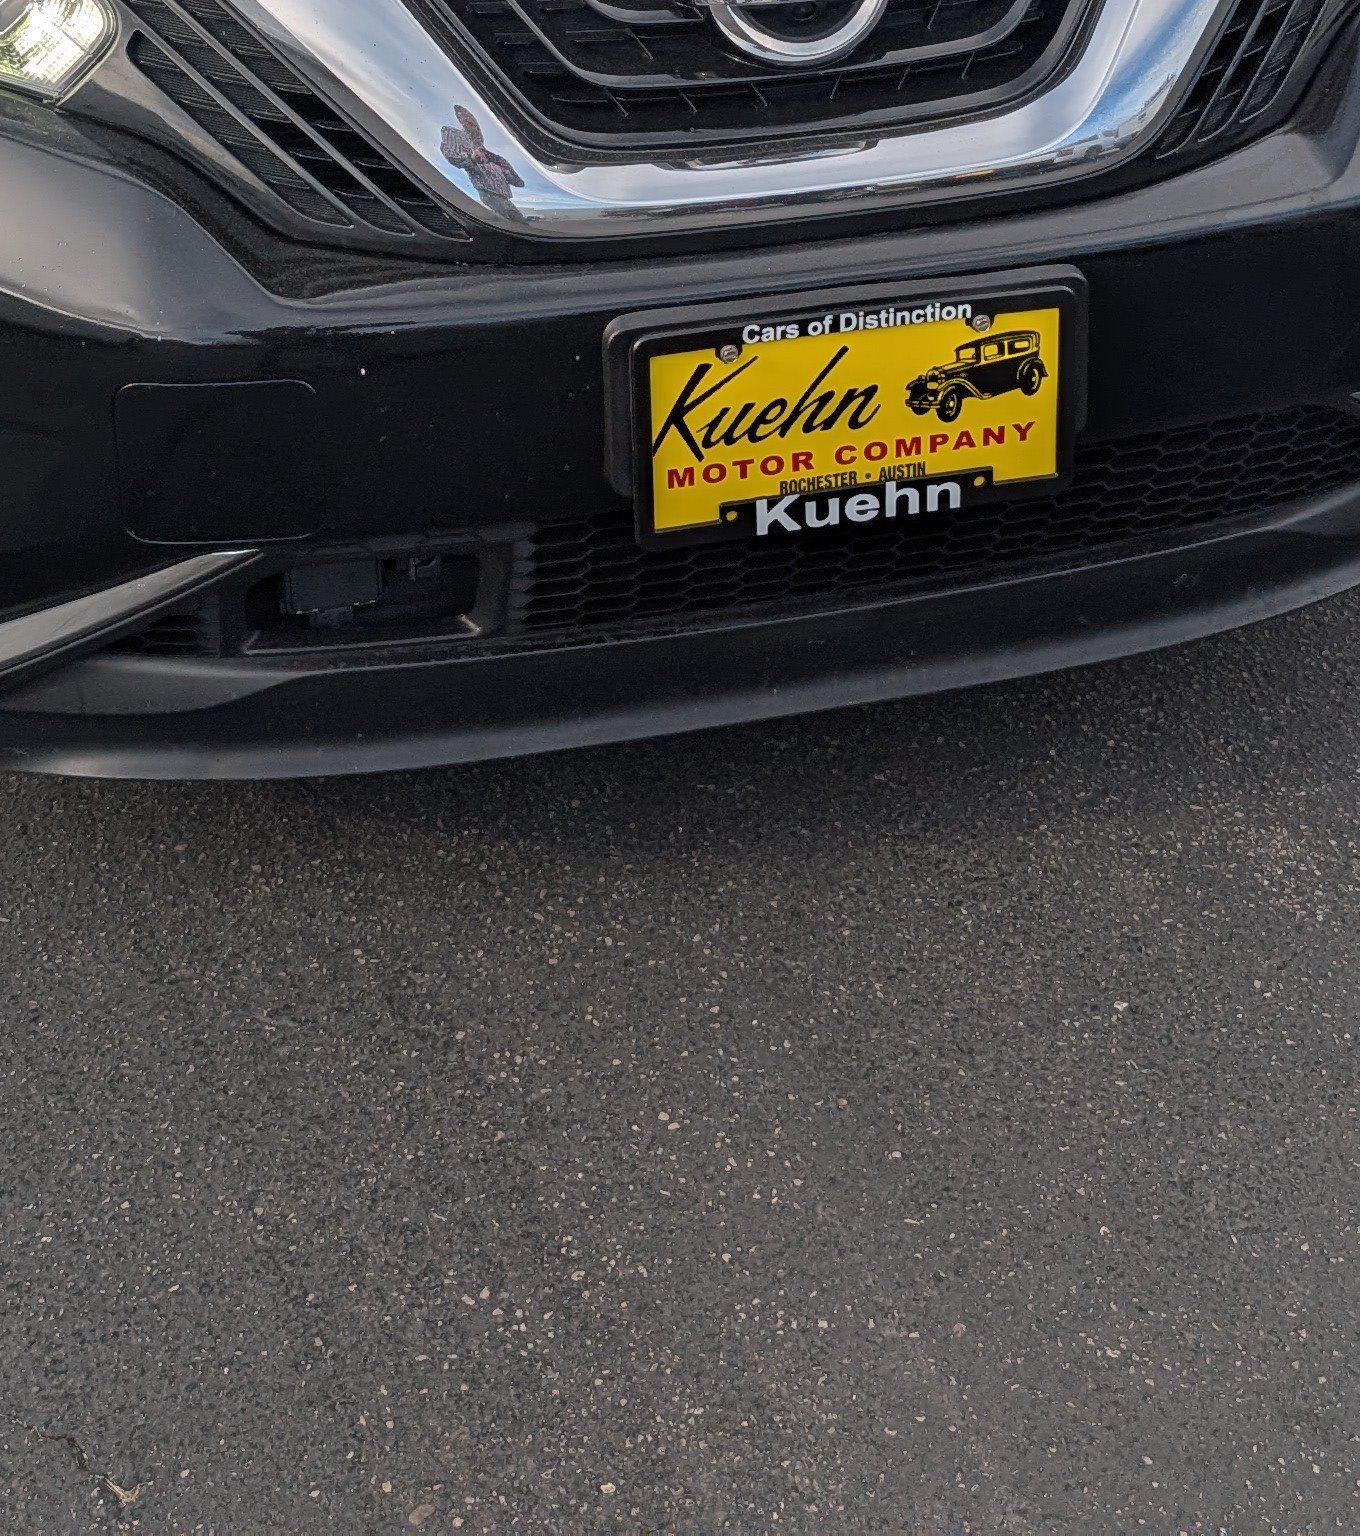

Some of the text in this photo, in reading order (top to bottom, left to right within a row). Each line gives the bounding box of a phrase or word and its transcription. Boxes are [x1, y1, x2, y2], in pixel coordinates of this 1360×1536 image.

[742, 301, 972, 345] Cars of Distinction
[652, 344, 882, 462] Kuehn
[667, 421, 1037, 490] MOTOR COMPANY
[779, 460, 927, 495] ROCHESTER AUSTIN
[755, 478, 962, 536] Kuehn
